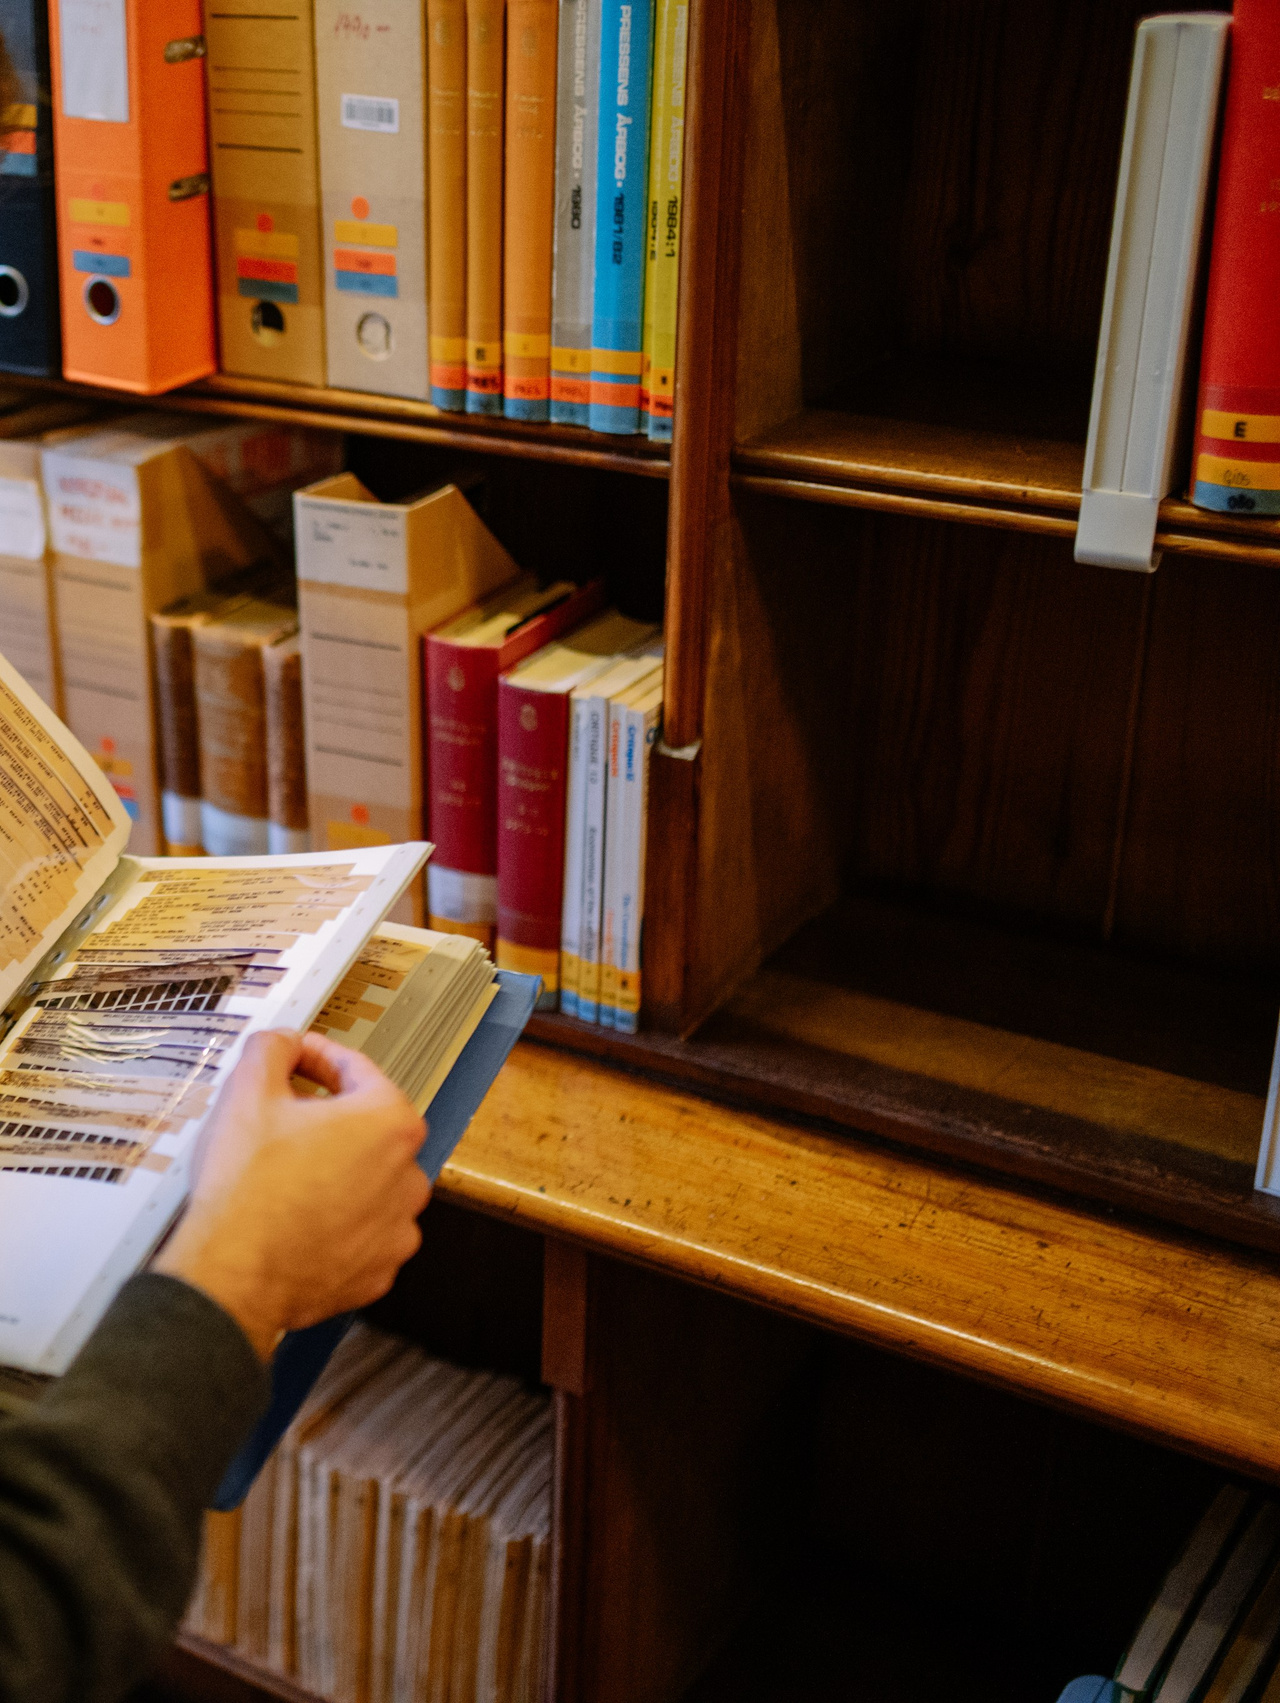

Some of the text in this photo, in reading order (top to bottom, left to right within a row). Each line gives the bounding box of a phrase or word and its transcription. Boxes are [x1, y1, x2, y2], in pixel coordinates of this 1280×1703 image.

[617, 5, 632, 106] PRESSENS
[671, 5, 686, 106] PRESSENS
[612, 193, 625, 265] 1981/82
[665, 196, 678, 258] 1984:1
[1234, 421, 1248, 438] E
